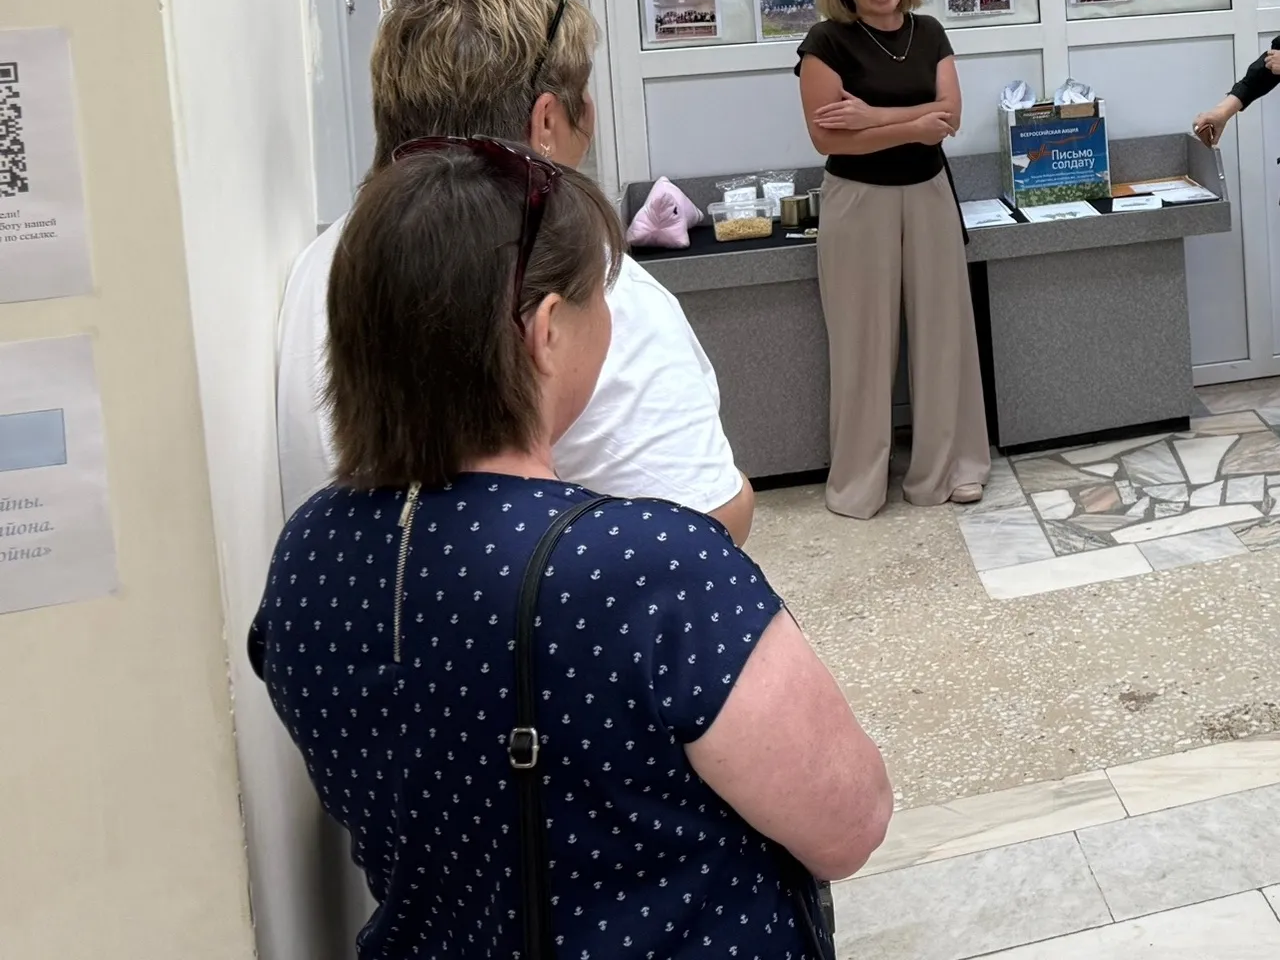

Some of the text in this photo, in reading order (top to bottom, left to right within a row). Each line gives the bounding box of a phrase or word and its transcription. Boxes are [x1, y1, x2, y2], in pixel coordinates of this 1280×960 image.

[1020, 129, 1060, 138] ВСЕРОССИЙСКАЯ
[1051, 149, 1093, 160] Письмо
[1052, 158, 1095, 170] солдату
[24, 218, 56, 228] нашей
[20, 232, 58, 240] ссылке.
